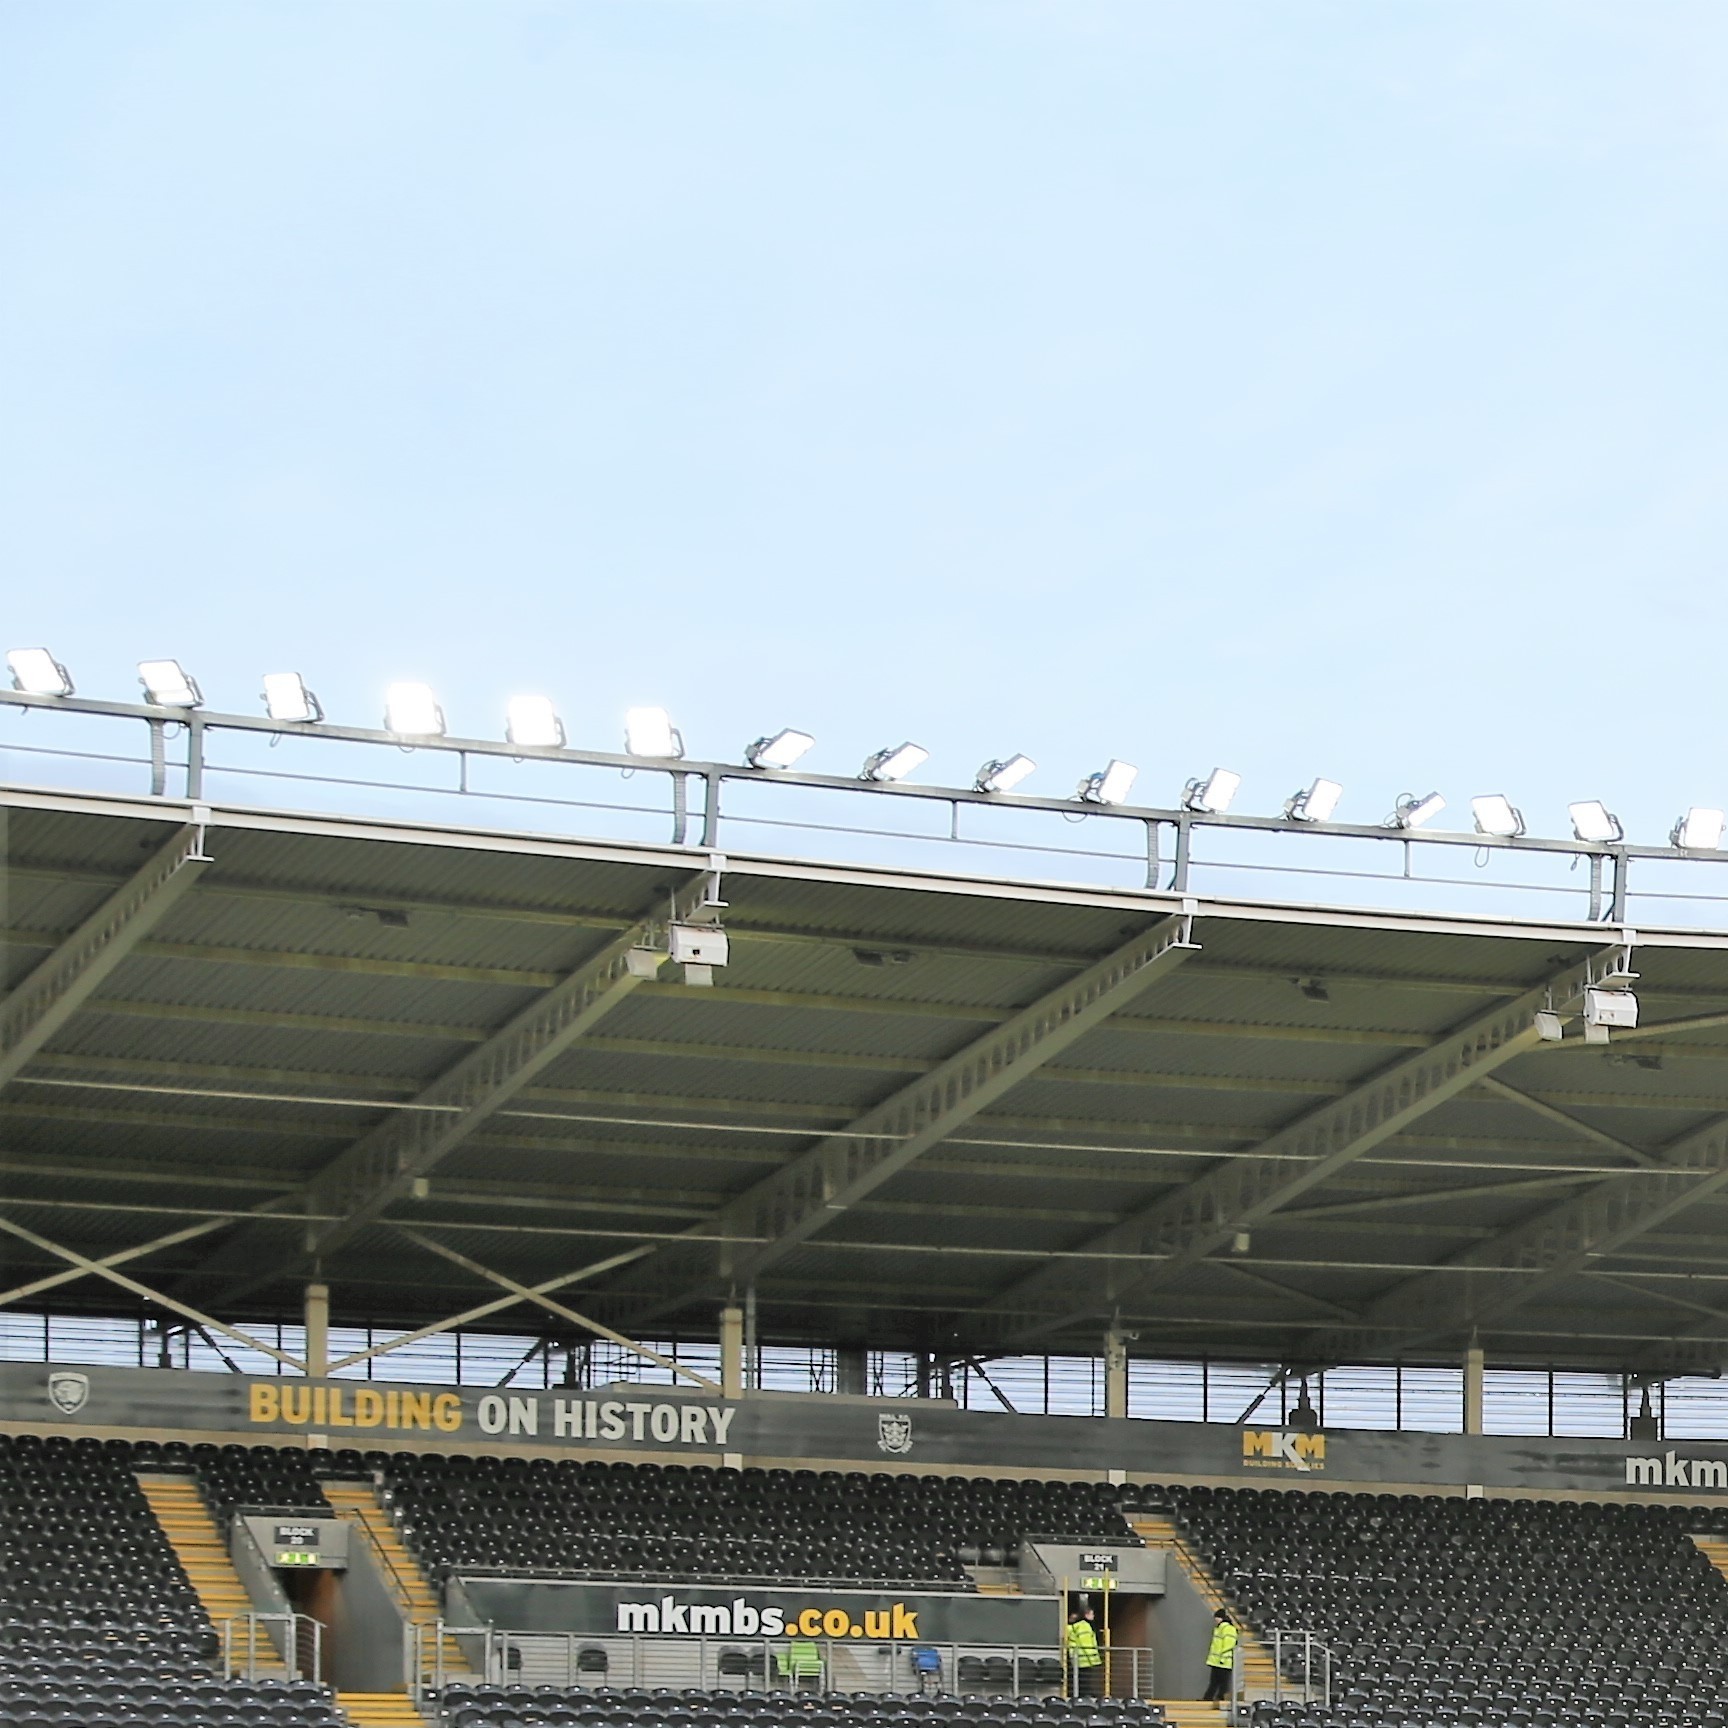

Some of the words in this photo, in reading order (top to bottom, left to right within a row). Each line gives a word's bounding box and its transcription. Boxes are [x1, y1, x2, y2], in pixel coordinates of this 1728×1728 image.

[251, 1383, 462, 1432] BUILDING
[477, 1394, 538, 1436] ON
[554, 1400, 736, 1445] HISTORY
[1243, 1431, 1325, 1472] MKM
[280, 1527, 315, 1536] BLOCK
[1084, 1555, 1113, 1564] BLOCK
[617, 1595, 920, 1639] mkmbs.co.uk
